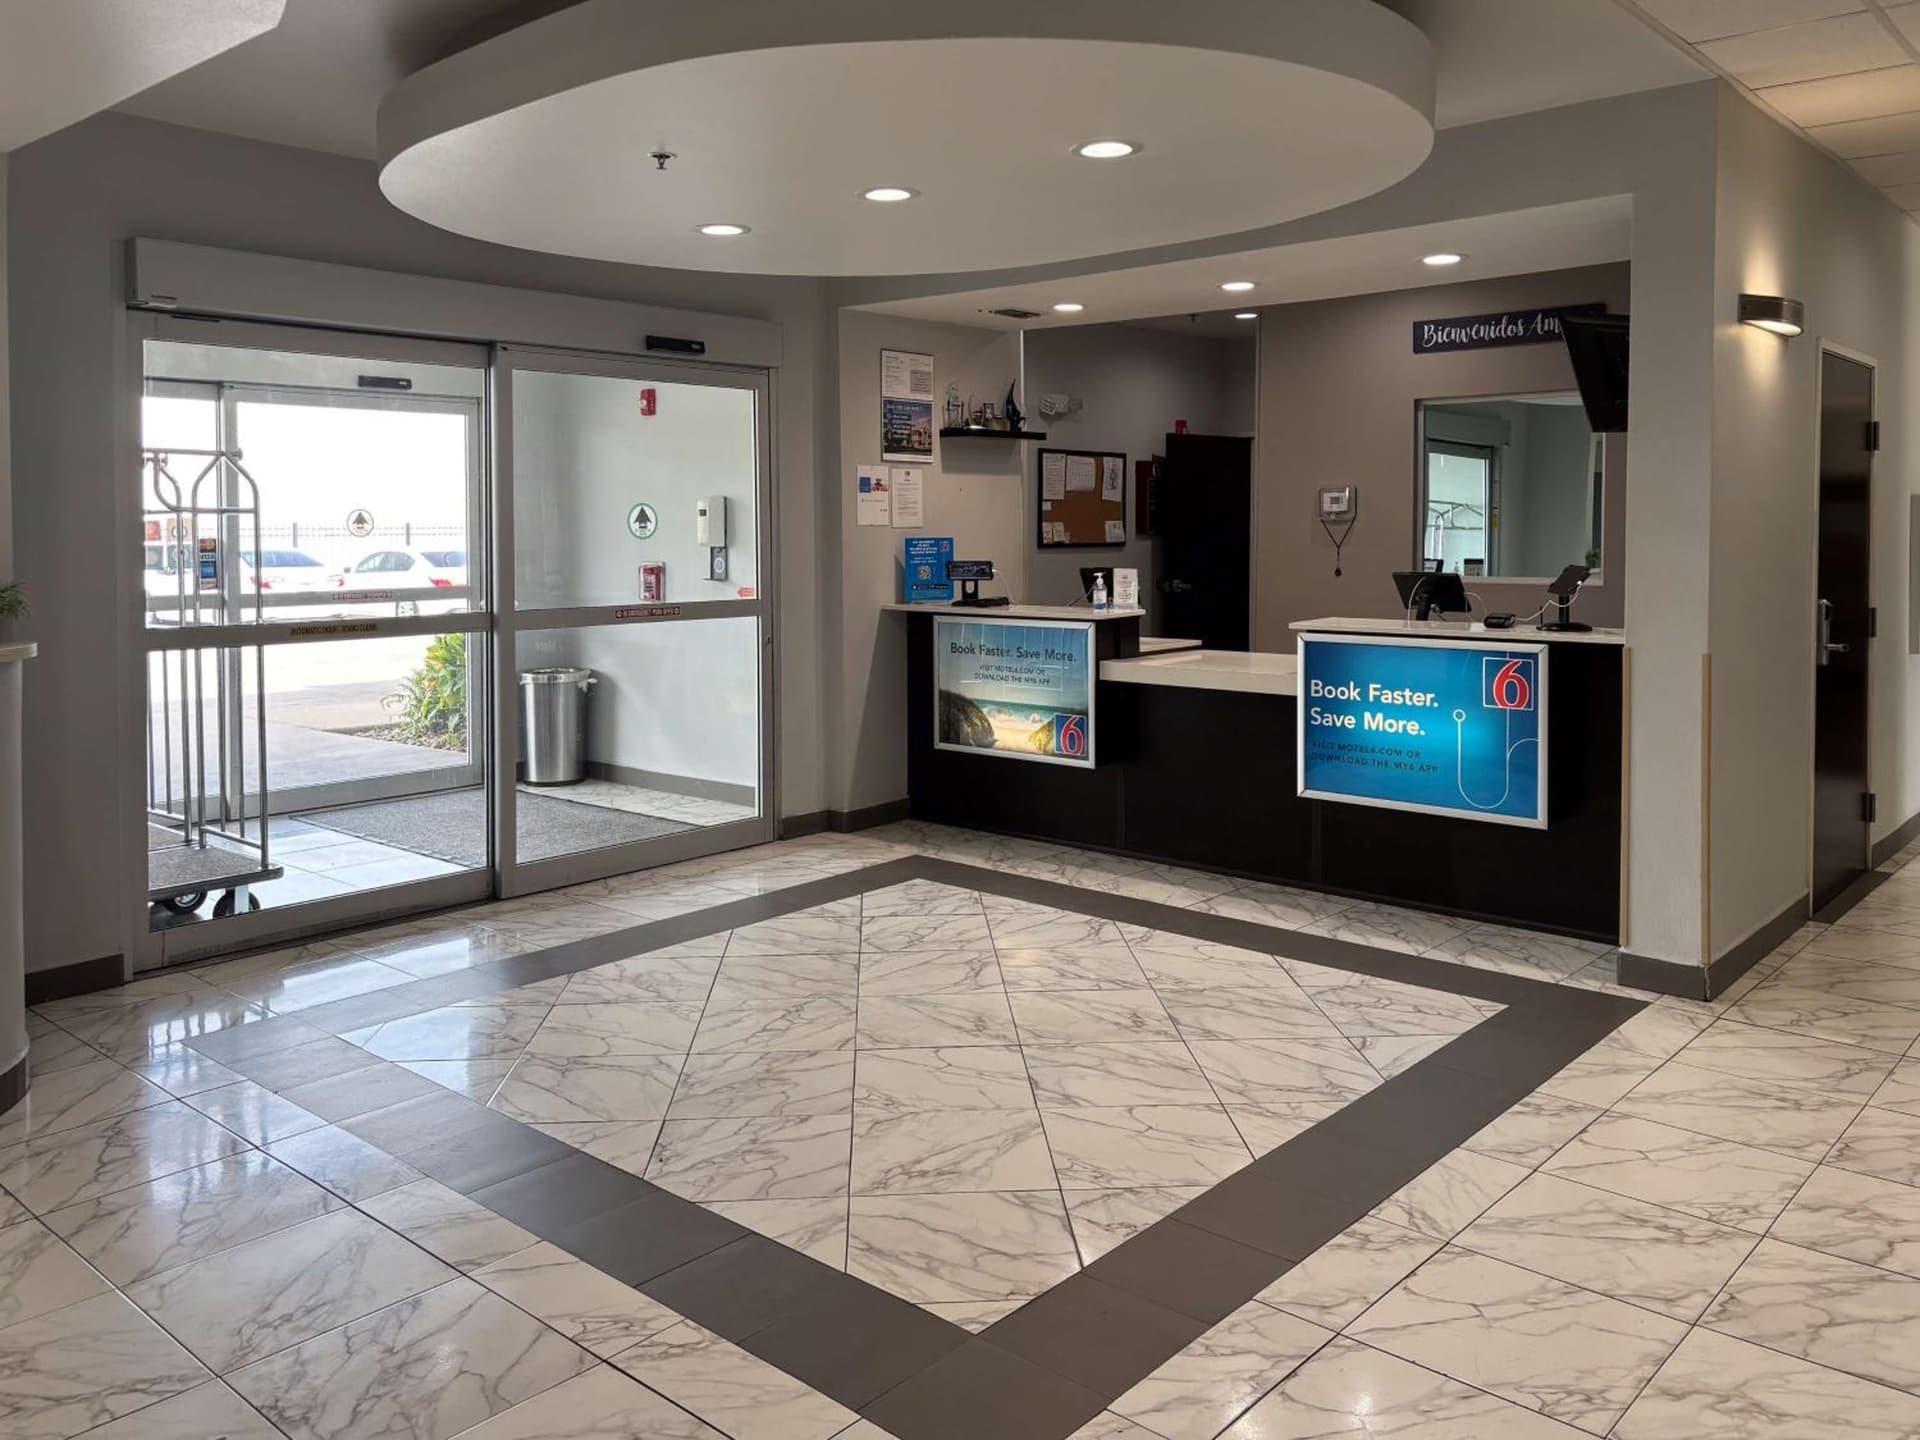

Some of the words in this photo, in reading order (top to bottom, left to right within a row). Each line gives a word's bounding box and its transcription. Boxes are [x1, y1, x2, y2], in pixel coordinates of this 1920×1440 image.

[1423, 315, 1524, 348] Bienvenidos
[950, 642, 976, 655] Book
[979, 644, 1013, 657] Faster.
[1016, 646, 1041, 659] Save
[1045, 648, 1077, 662] More.
[1310, 679, 1361, 701] Book
[1368, 683, 1439, 708] Faster.
[1493, 658, 1530, 710] 6
[1060, 714, 1085, 756] 6
[1310, 707, 1356, 729] Save
[1363, 711, 1426, 736] More.
[1312, 741, 1335, 751] VISIT
[1337, 743, 1402, 757] MOTEL6.COM
[1406, 750, 1421, 759] OR
[1312, 752, 1368, 766] DOWNLOAD
[1372, 759, 1389, 768] THE
[1394, 761, 1415, 771] MY6
[1418, 765, 1439, 773] APP
